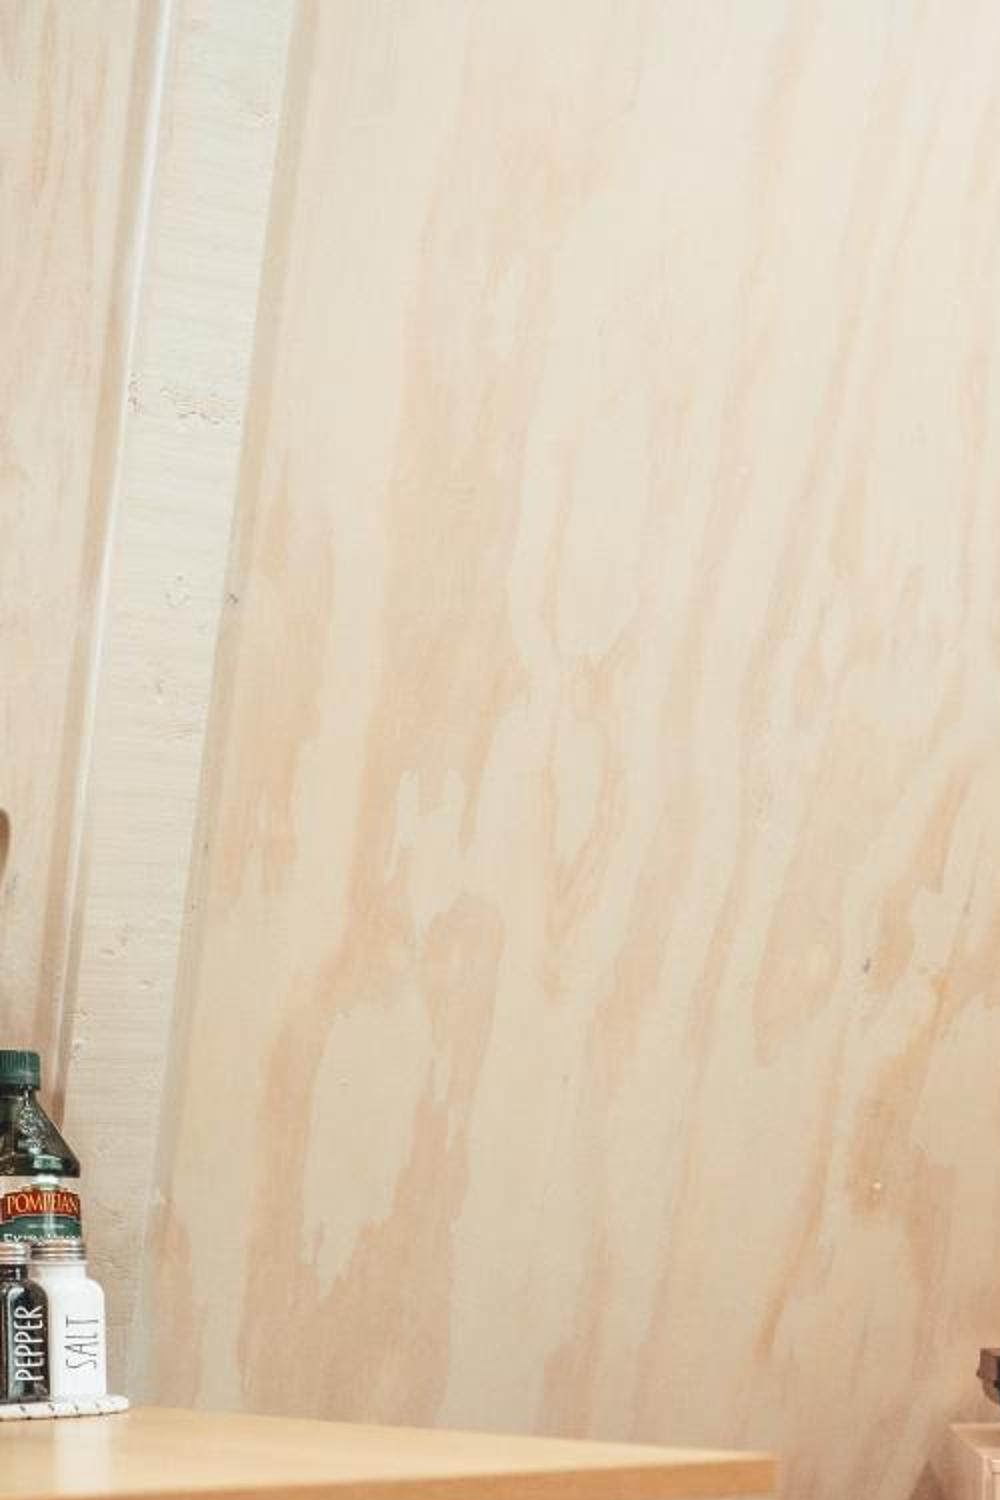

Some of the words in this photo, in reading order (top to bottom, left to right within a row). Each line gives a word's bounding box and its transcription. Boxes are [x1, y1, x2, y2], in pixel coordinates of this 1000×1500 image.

[7, 1192, 79, 1214] POMPEIAN
[14, 1305, 44, 1381] PEPPER
[63, 1314, 99, 1369] SALT
